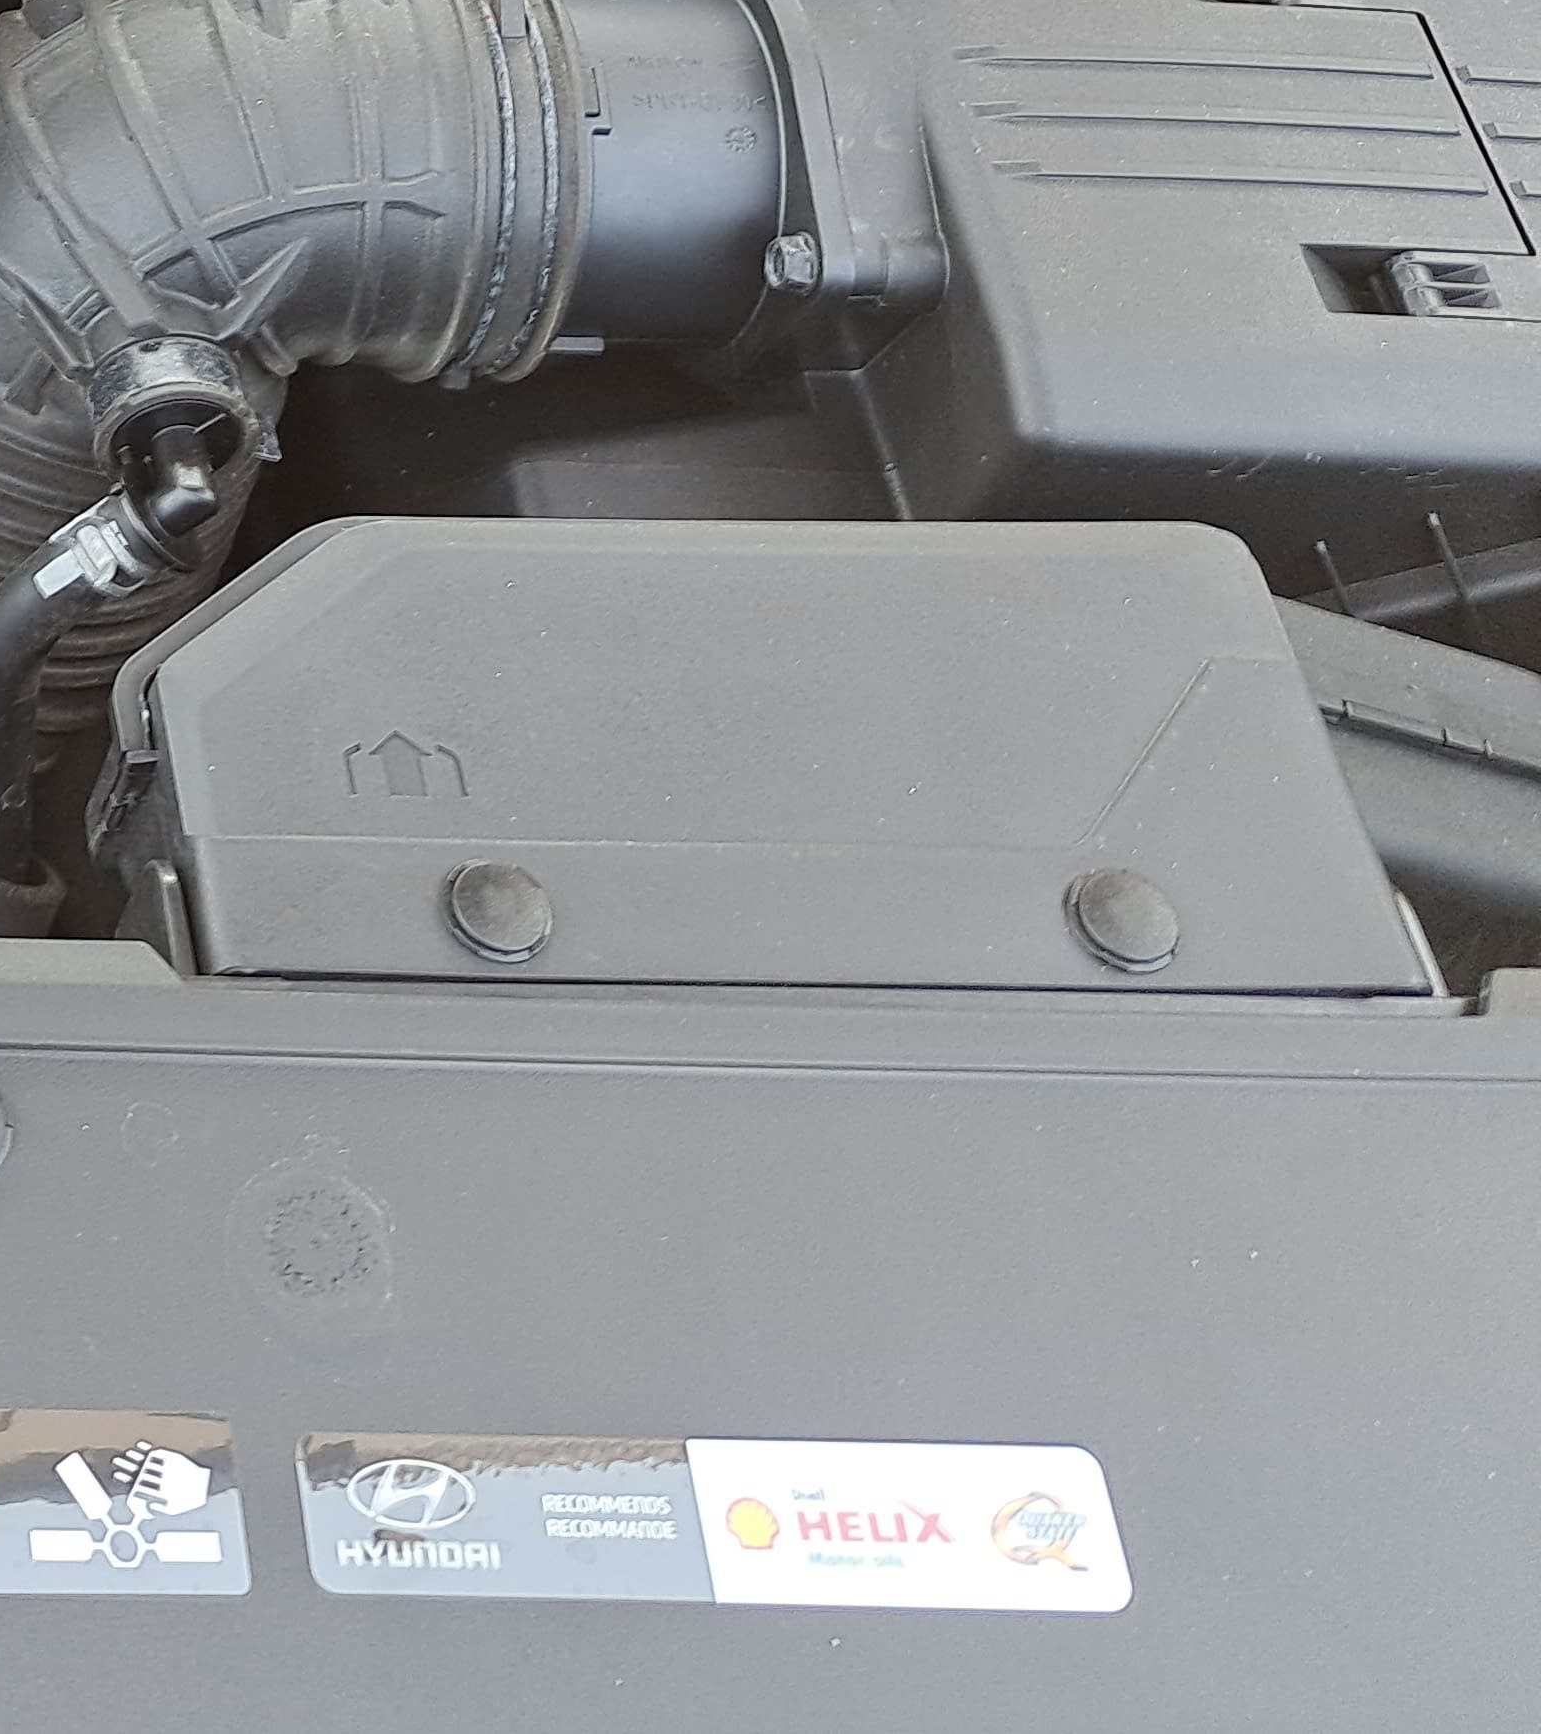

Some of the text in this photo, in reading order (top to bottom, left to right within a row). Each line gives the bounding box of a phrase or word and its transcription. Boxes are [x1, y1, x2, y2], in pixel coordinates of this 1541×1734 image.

[541, 1493, 673, 1515] RECOMMENDS
[544, 1518, 678, 1540] RECOMMANDE
[797, 1497, 955, 1544] HELIX
[336, 1538, 502, 1570] HYUNDAI
